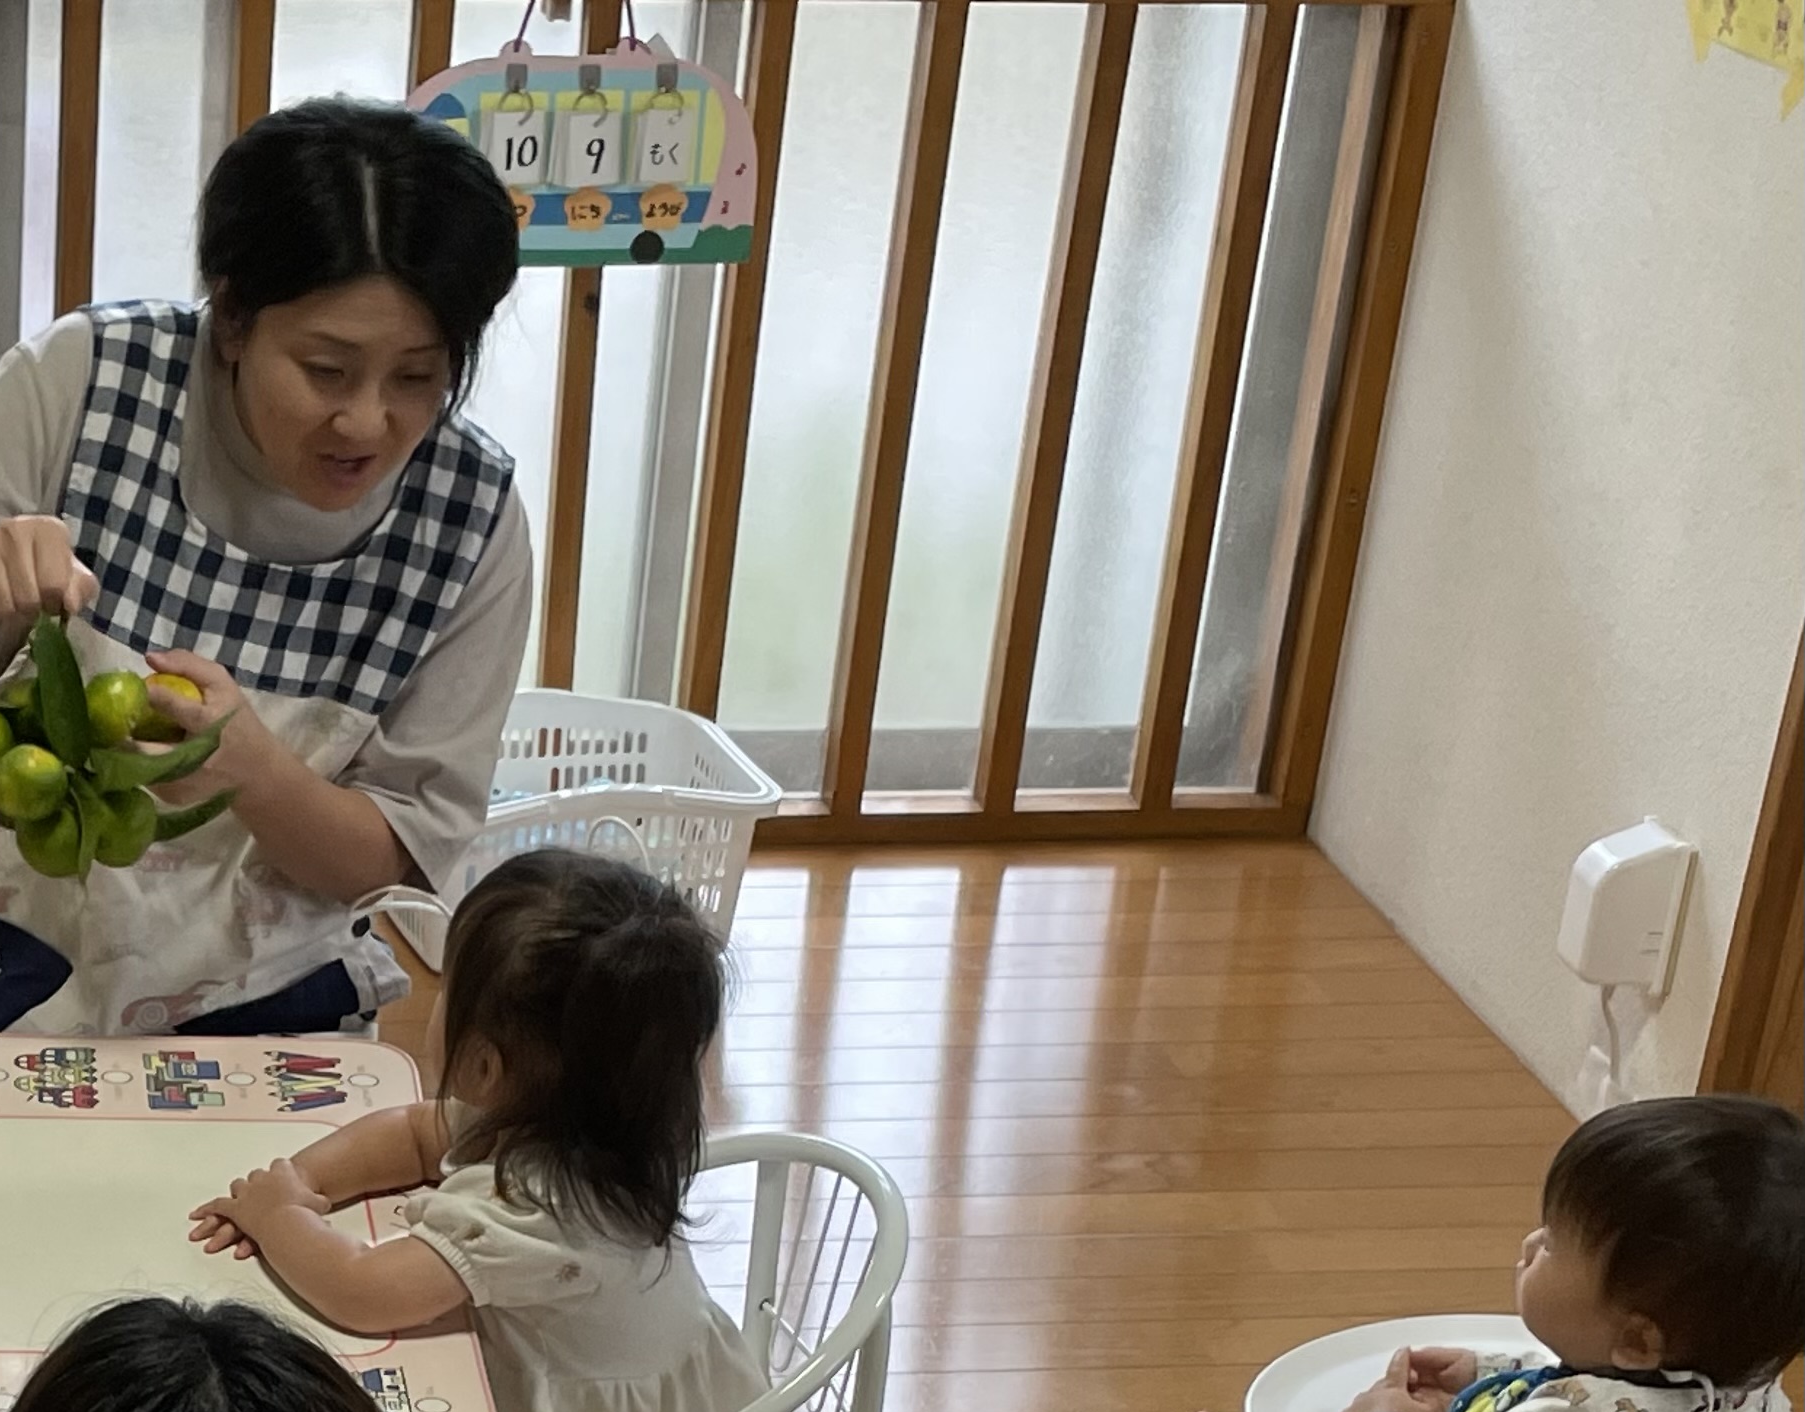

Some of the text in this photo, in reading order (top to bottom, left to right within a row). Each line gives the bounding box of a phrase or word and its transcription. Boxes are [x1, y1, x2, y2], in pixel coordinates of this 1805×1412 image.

[504, 135, 605, 174] 10 9
[649, 143, 680, 165] もく
